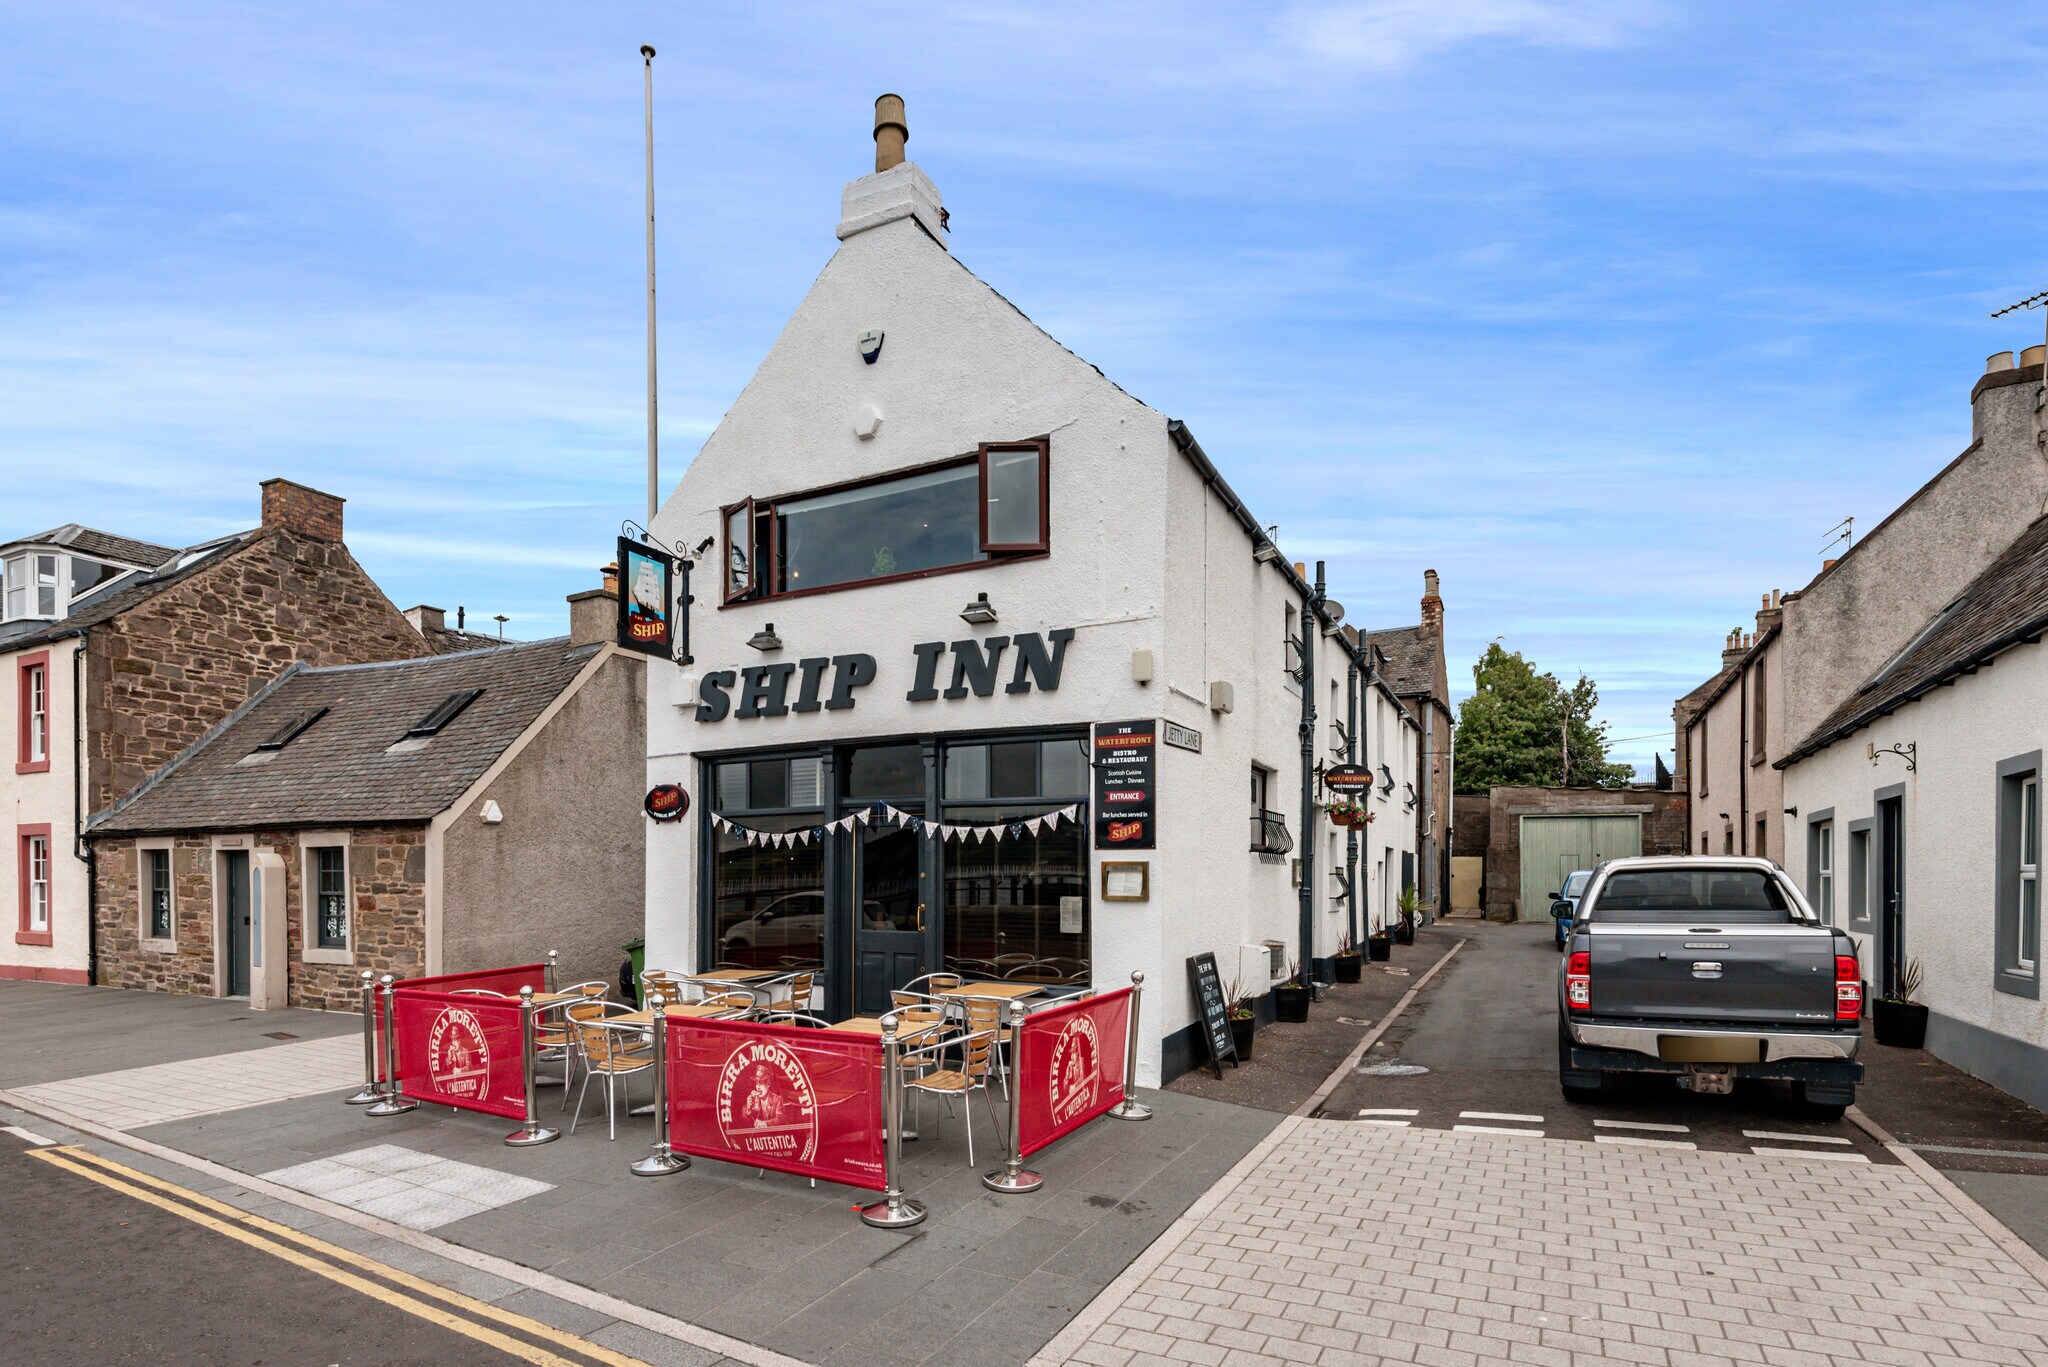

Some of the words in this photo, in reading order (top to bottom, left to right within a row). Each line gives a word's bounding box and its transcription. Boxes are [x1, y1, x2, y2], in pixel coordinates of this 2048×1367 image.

[633, 622, 665, 637] SHIP
[694, 653, 878, 723] SHIP
[906, 628, 1076, 702] INN
[1098, 736, 1152, 746] WATERFRONT
[1168, 726, 1184, 743] JETTY
[1184, 732, 1198, 748] LANE
[1108, 756, 1148, 764] RESTAURANT
[655, 791, 677, 808] SHIP
[1109, 792, 1140, 801] ENTRANCE
[1112, 822, 1140, 839] SHIP
[431, 1016, 450, 1072] BIRRA
[448, 1010, 488, 1064] MORETTI
[1052, 1032, 1070, 1103] BIRRA
[1070, 1017, 1098, 1067] MORETTI
[446, 1078, 477, 1094] L'AUTENTICA
[721, 1052, 750, 1123] BIRRA
[751, 1045, 814, 1116] MORETTI
[745, 1134, 798, 1152] L'AUTENTICA
